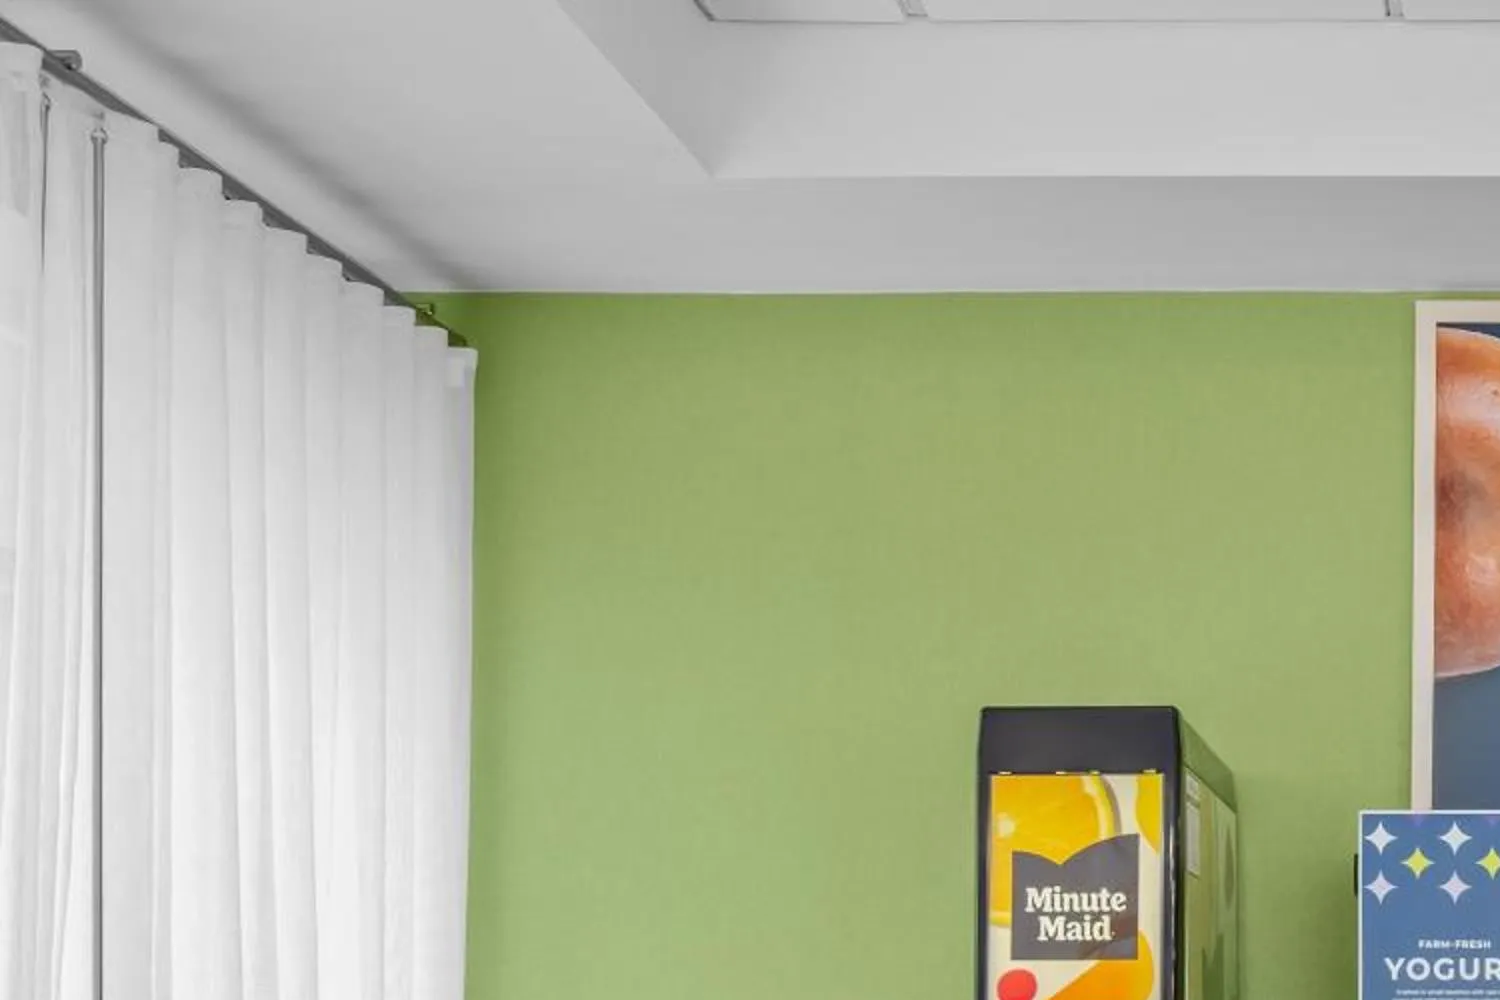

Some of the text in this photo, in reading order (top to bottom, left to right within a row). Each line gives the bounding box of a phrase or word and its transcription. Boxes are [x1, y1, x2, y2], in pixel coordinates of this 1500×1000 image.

[1024, 886, 1127, 913] Minute
[1036, 914, 1113, 941] Maid
[1418, 938, 1491, 949] FARM-FRESH
